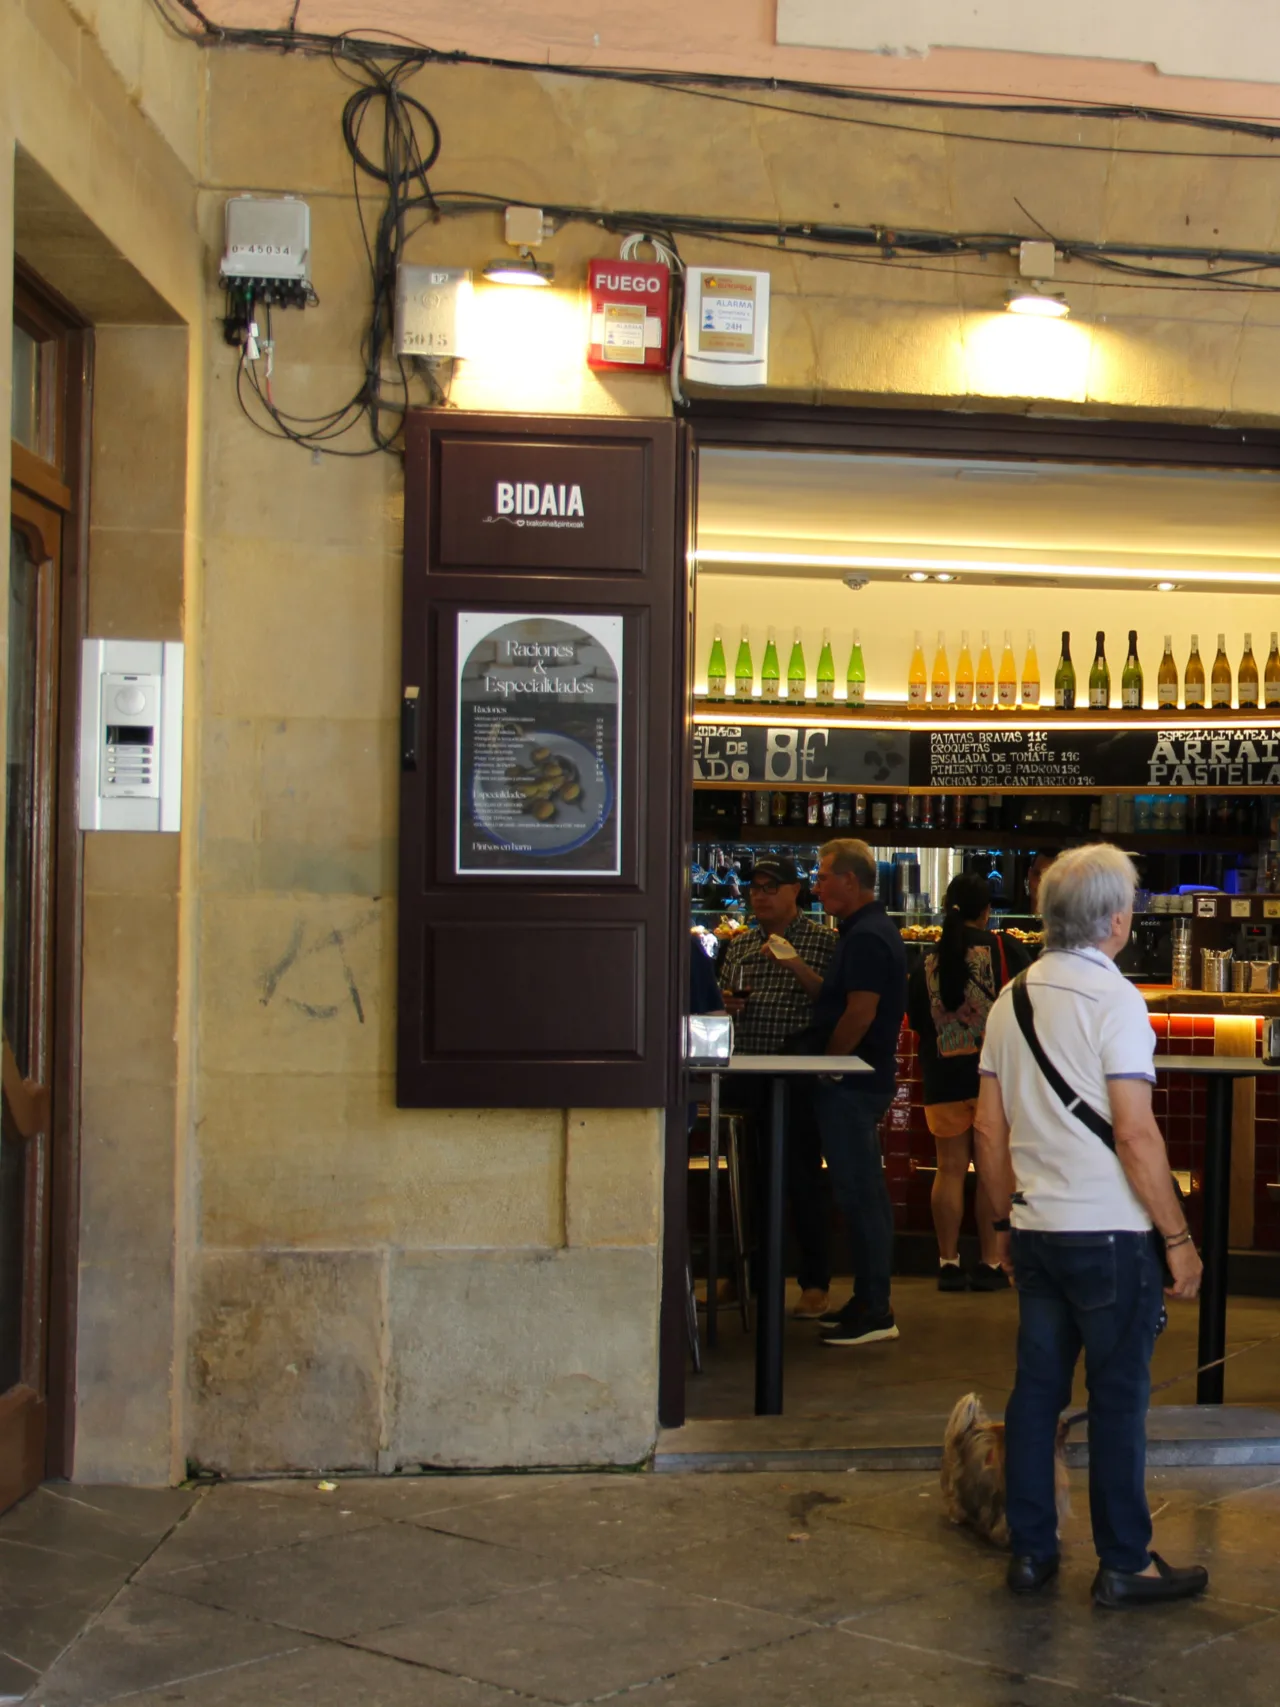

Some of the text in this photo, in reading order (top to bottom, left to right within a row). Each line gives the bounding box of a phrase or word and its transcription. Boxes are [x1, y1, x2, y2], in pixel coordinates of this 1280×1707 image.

[595, 274, 661, 293] FUEGO
[716, 299, 752, 310] ALARMA
[725, 322, 742, 331] 24H
[496, 482, 585, 517] BIDAIA
[506, 640, 574, 657] Raciones
[533, 659, 547, 675] &
[485, 676, 594, 698] Especialidades
[930, 733, 975, 745] PATATAS
[978, 731, 1023, 743] BRAVAS
[1157, 729, 1269, 742] ESPEZIALITATEA
[726, 741, 749, 755] DE
[930, 743, 991, 754] CROQUETAS
[930, 754, 987, 764] ENSALADA
[992, 753, 1006, 762] DE
[1009, 752, 1055, 762] TOMATE
[930, 764, 994, 775] PIMIENTOS
[997, 764, 1012, 774] DE
[930, 776, 977, 786] ANCHOAS
[980, 776, 1002, 786] DEL
